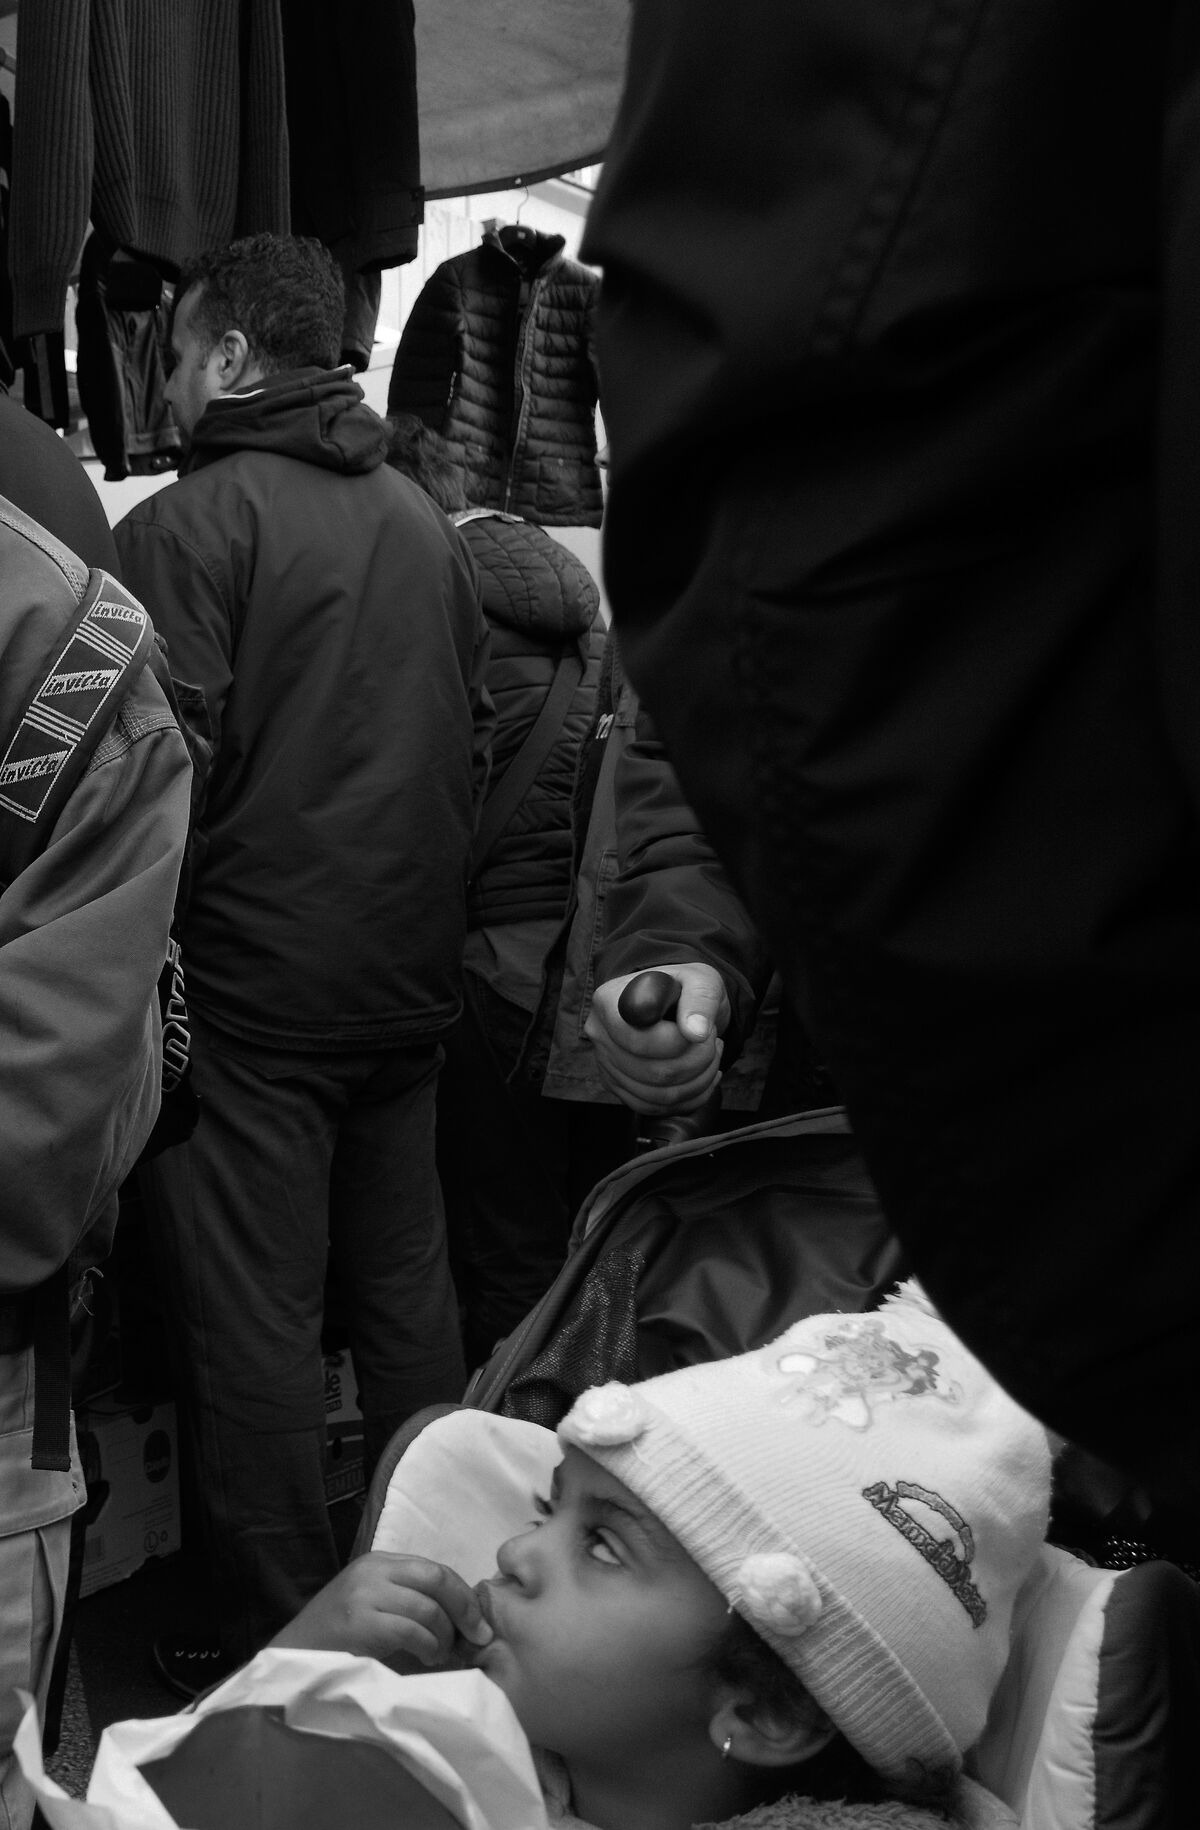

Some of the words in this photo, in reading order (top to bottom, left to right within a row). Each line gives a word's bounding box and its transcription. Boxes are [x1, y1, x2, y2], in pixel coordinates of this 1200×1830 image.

[93, 602, 142, 623] invicta
[48, 673, 110, 696] invicta
[2, 756, 59, 784] invicta
